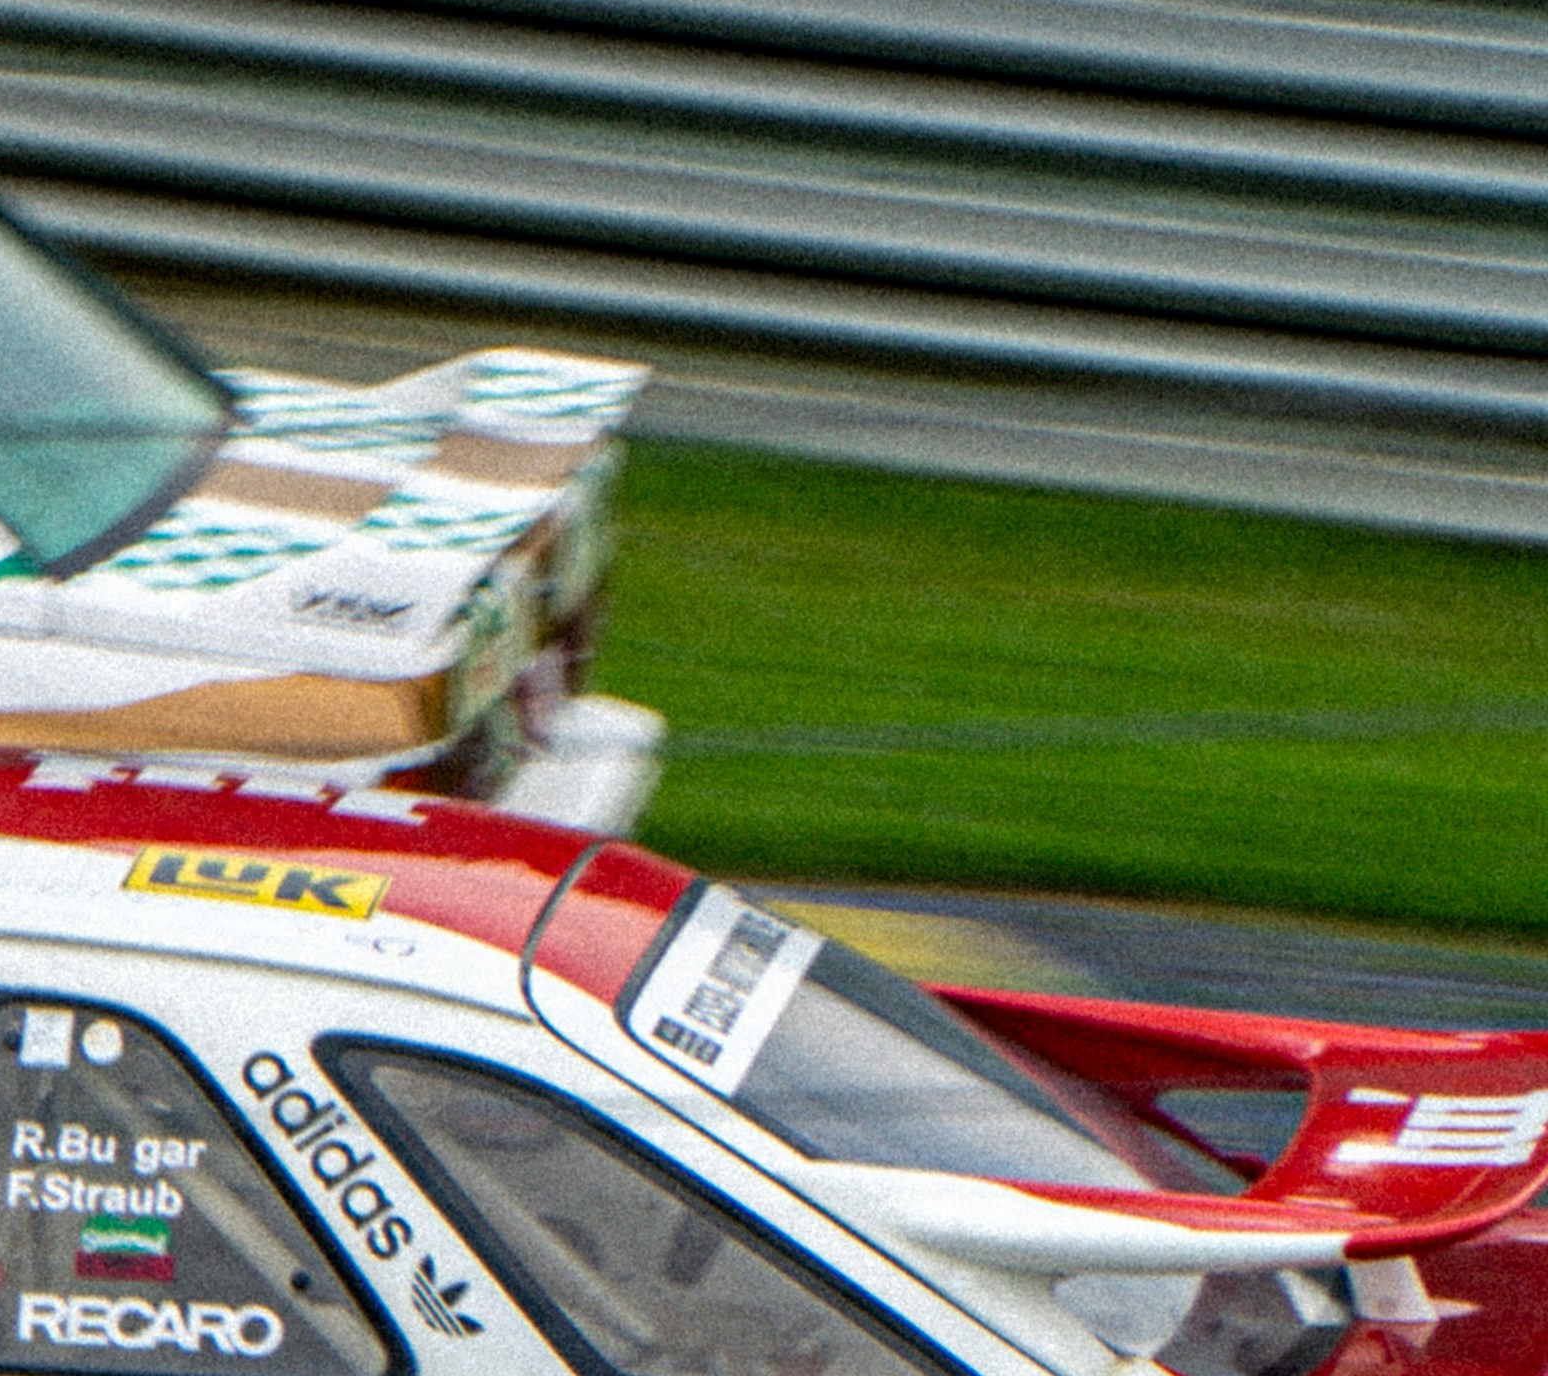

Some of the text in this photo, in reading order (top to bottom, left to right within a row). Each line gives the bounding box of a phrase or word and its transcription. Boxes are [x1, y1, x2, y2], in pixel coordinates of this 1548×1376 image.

[242, 1052, 413, 1261] adidas
[6, 1170, 184, 1218] F.Straub
[17, 1293, 285, 1357] RECARO
